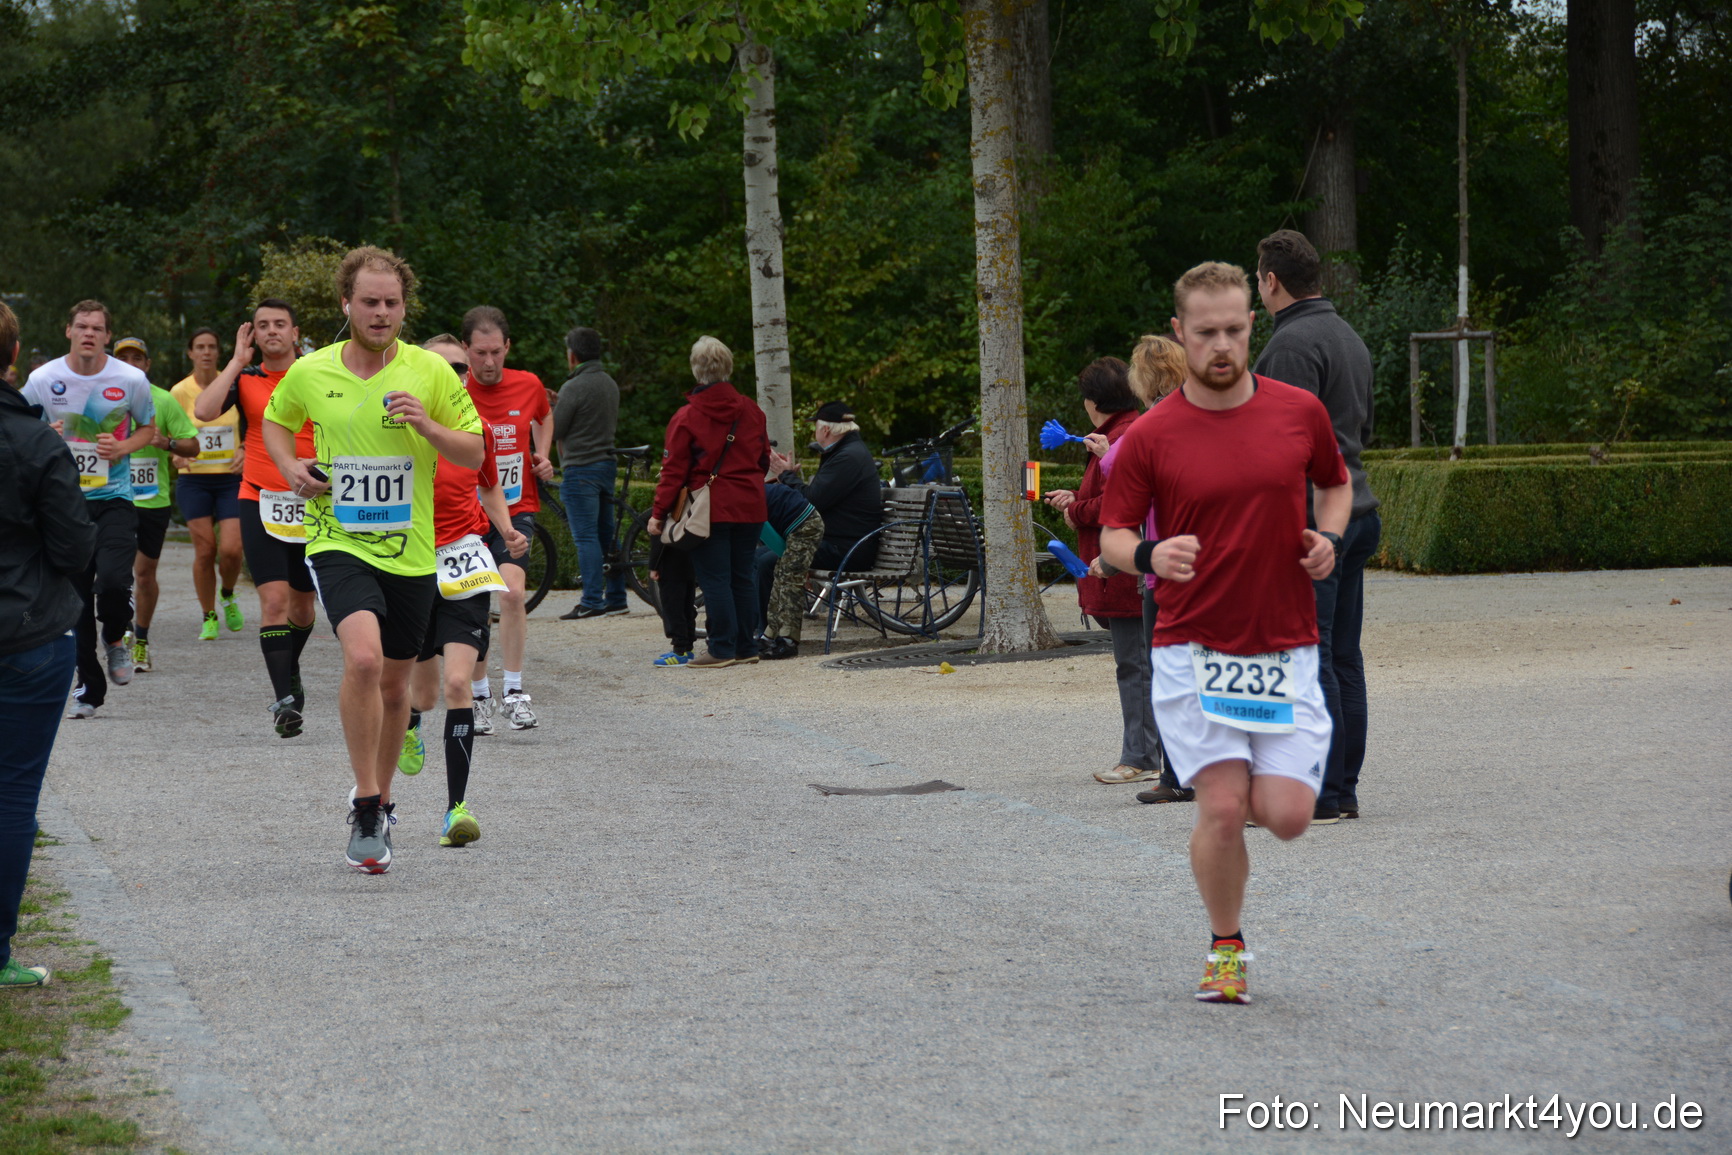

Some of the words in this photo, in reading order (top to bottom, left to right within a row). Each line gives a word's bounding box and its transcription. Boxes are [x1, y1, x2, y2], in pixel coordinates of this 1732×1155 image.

[205, 434, 223, 450] 34
[333, 462, 360, 471] PARTL
[361, 463, 401, 471] Neumarkt
[499, 465, 518, 487] 76
[340, 474, 404, 502] 2101
[261, 493, 282, 502] PARTL
[272, 503, 306, 523] 535
[357, 509, 389, 521] Gerrit
[450, 540, 481, 552] Neumarkt
[444, 550, 488, 579] 321
[460, 573, 493, 590] Marcel
[1204, 661, 1286, 698] 2232
[1213, 701, 1277, 720] Alexander
